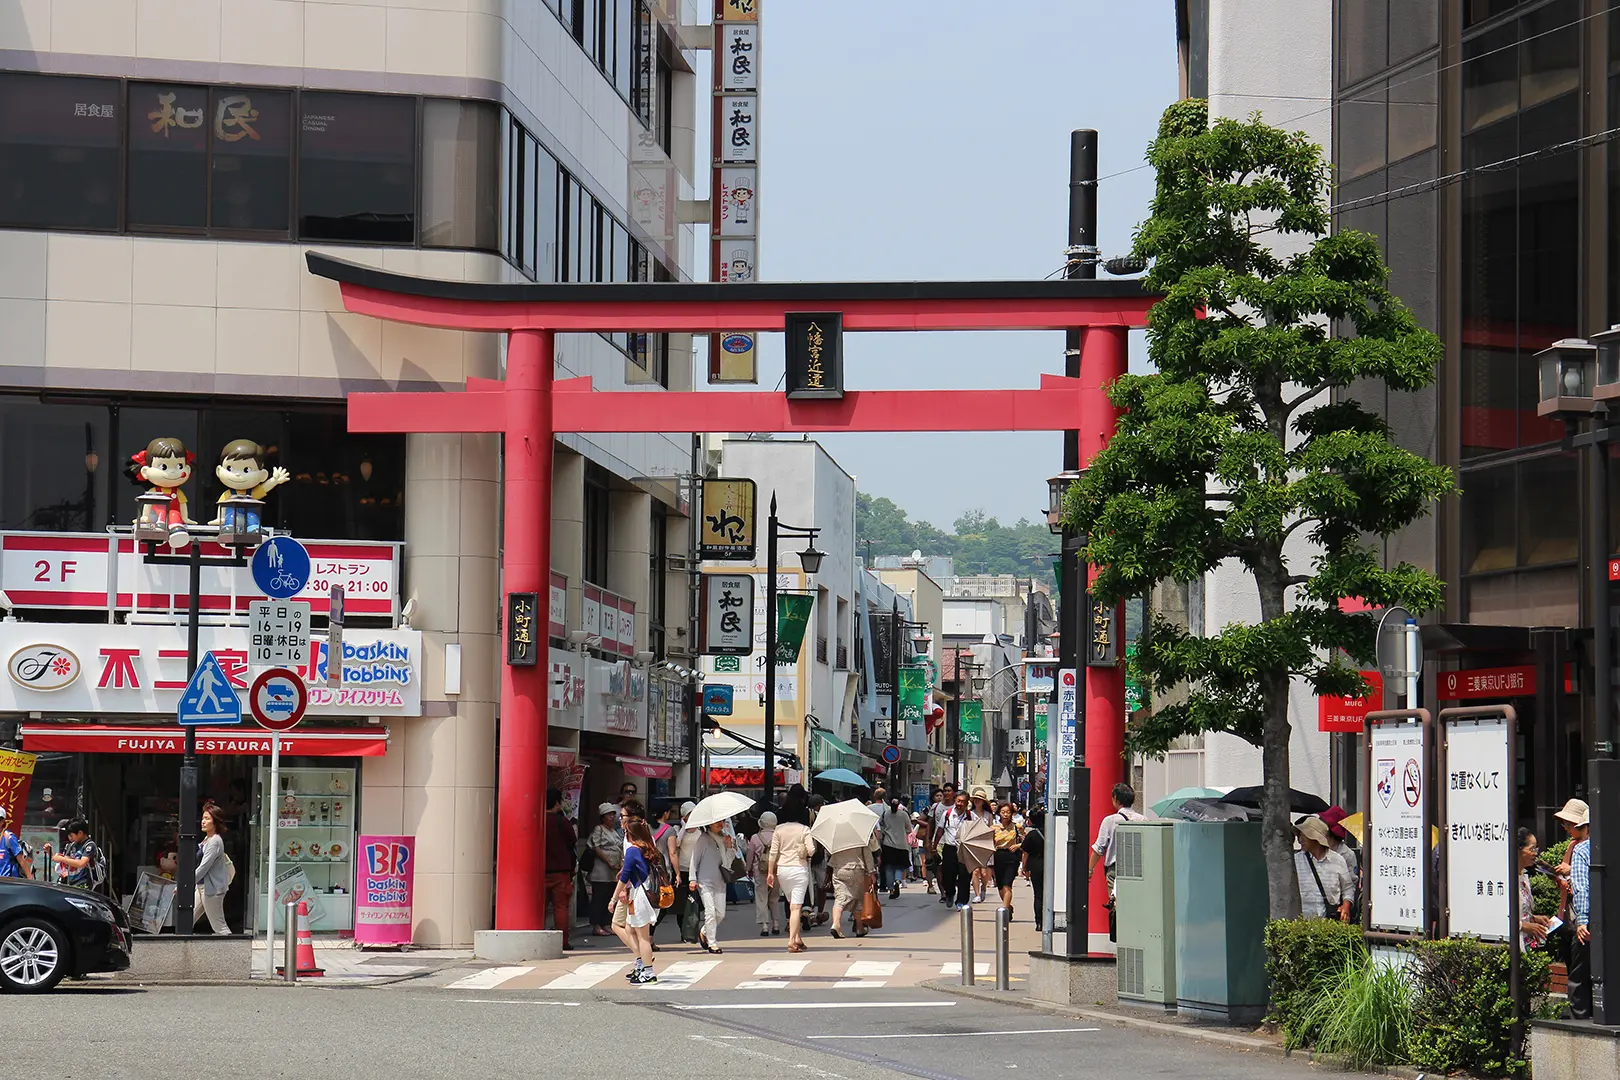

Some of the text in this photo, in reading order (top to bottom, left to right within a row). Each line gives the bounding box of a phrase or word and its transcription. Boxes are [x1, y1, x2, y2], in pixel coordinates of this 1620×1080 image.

[729, 37, 753, 75] 和民
[73, 102, 115, 118] 居食屋
[147, 91, 262, 142] 和民
[729, 109, 752, 147] 和民
[807, 321, 825, 388] 八幡宮近道
[705, 508, 746, 544] わん
[316, 563, 370, 575] レストラン
[306, 580, 388, 593] :30 21:00
[259, 606, 302, 618] 平日の
[717, 590, 744, 633] 和民
[514, 600, 532, 659] 小町通り
[1093, 600, 1111, 660] 小町通り
[342, 640, 409, 661] baskin
[343, 665, 411, 684] robbins
[1467, 673, 1525, 693] 三菱東京UFJ銀行
[337, 688, 403, 706] アイスクリーム
[1326, 715, 1365, 723] 三菱東京UF
[118, 739, 294, 752] FUJIYA ESTAURAT
[1450, 771, 1499, 790] 放置なくして
[3, 776, 26, 830] プレミア
[365, 842, 410, 876] BR
[367, 877, 407, 891] baskin
[368, 890, 408, 904] robbins
